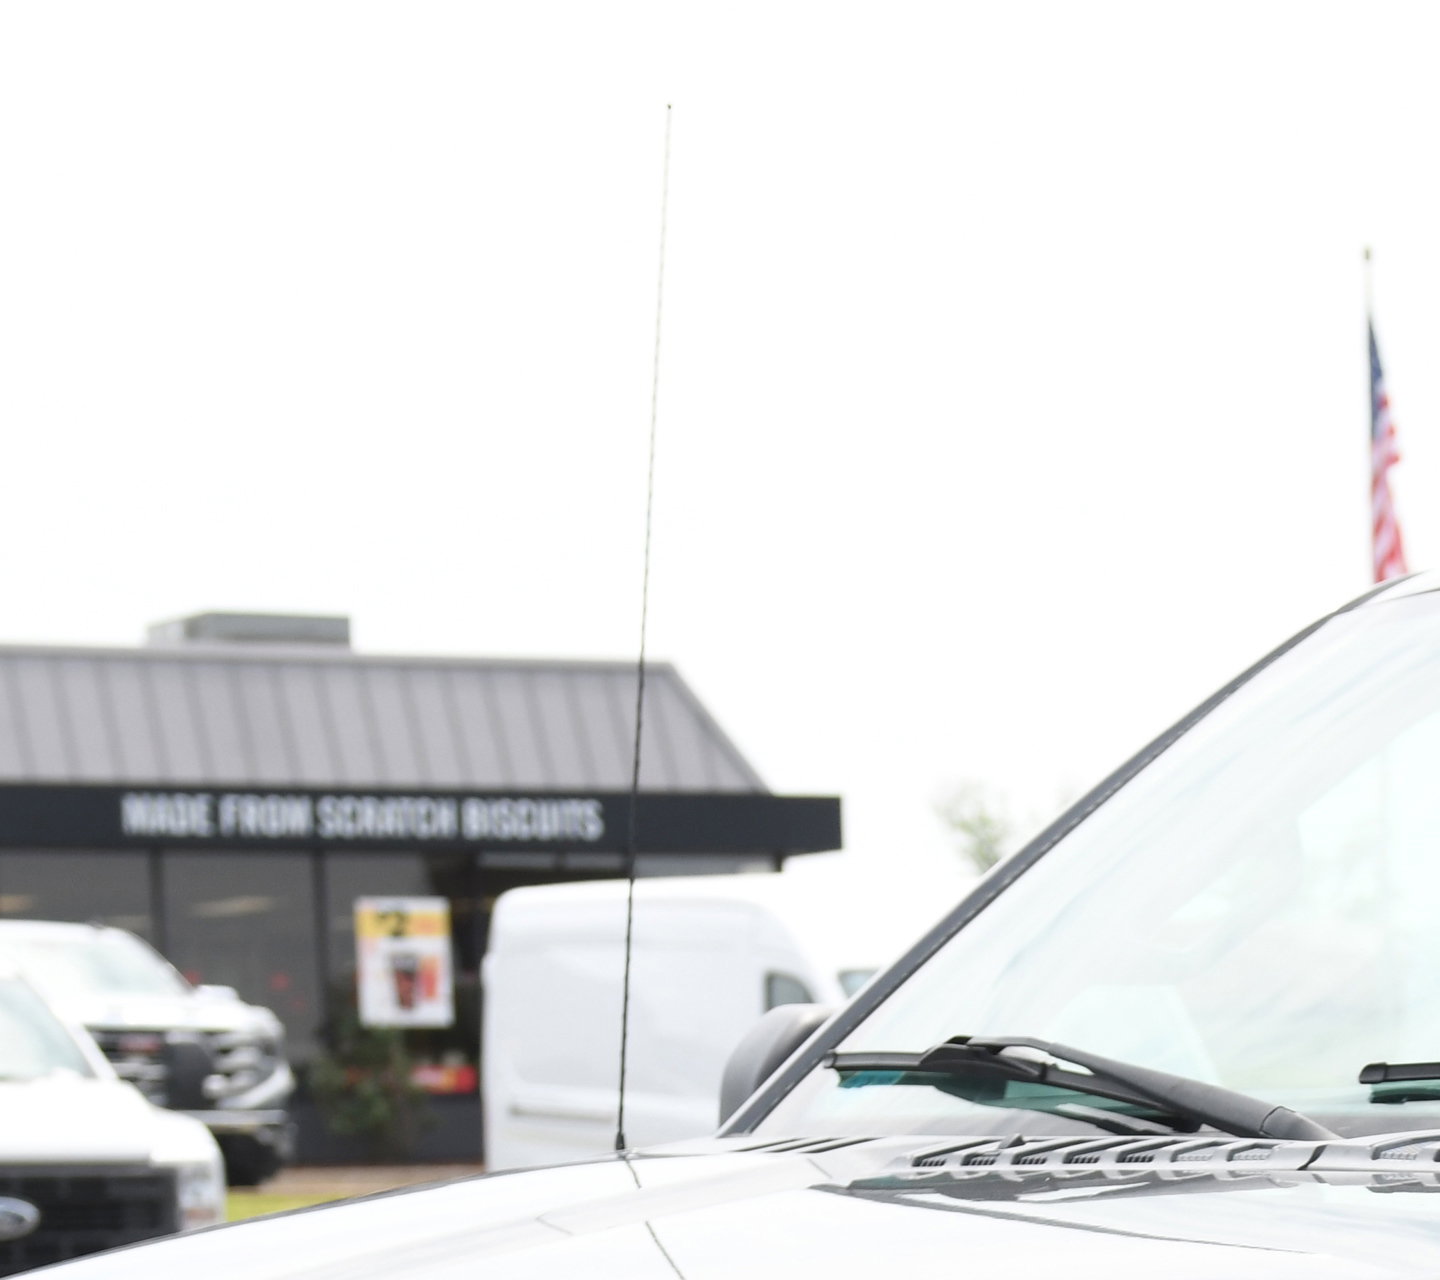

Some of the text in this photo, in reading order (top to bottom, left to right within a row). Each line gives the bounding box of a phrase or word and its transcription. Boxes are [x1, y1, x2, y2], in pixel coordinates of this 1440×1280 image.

[121, 793, 605, 841] MADE FROM SCRATCH BISCUITS
